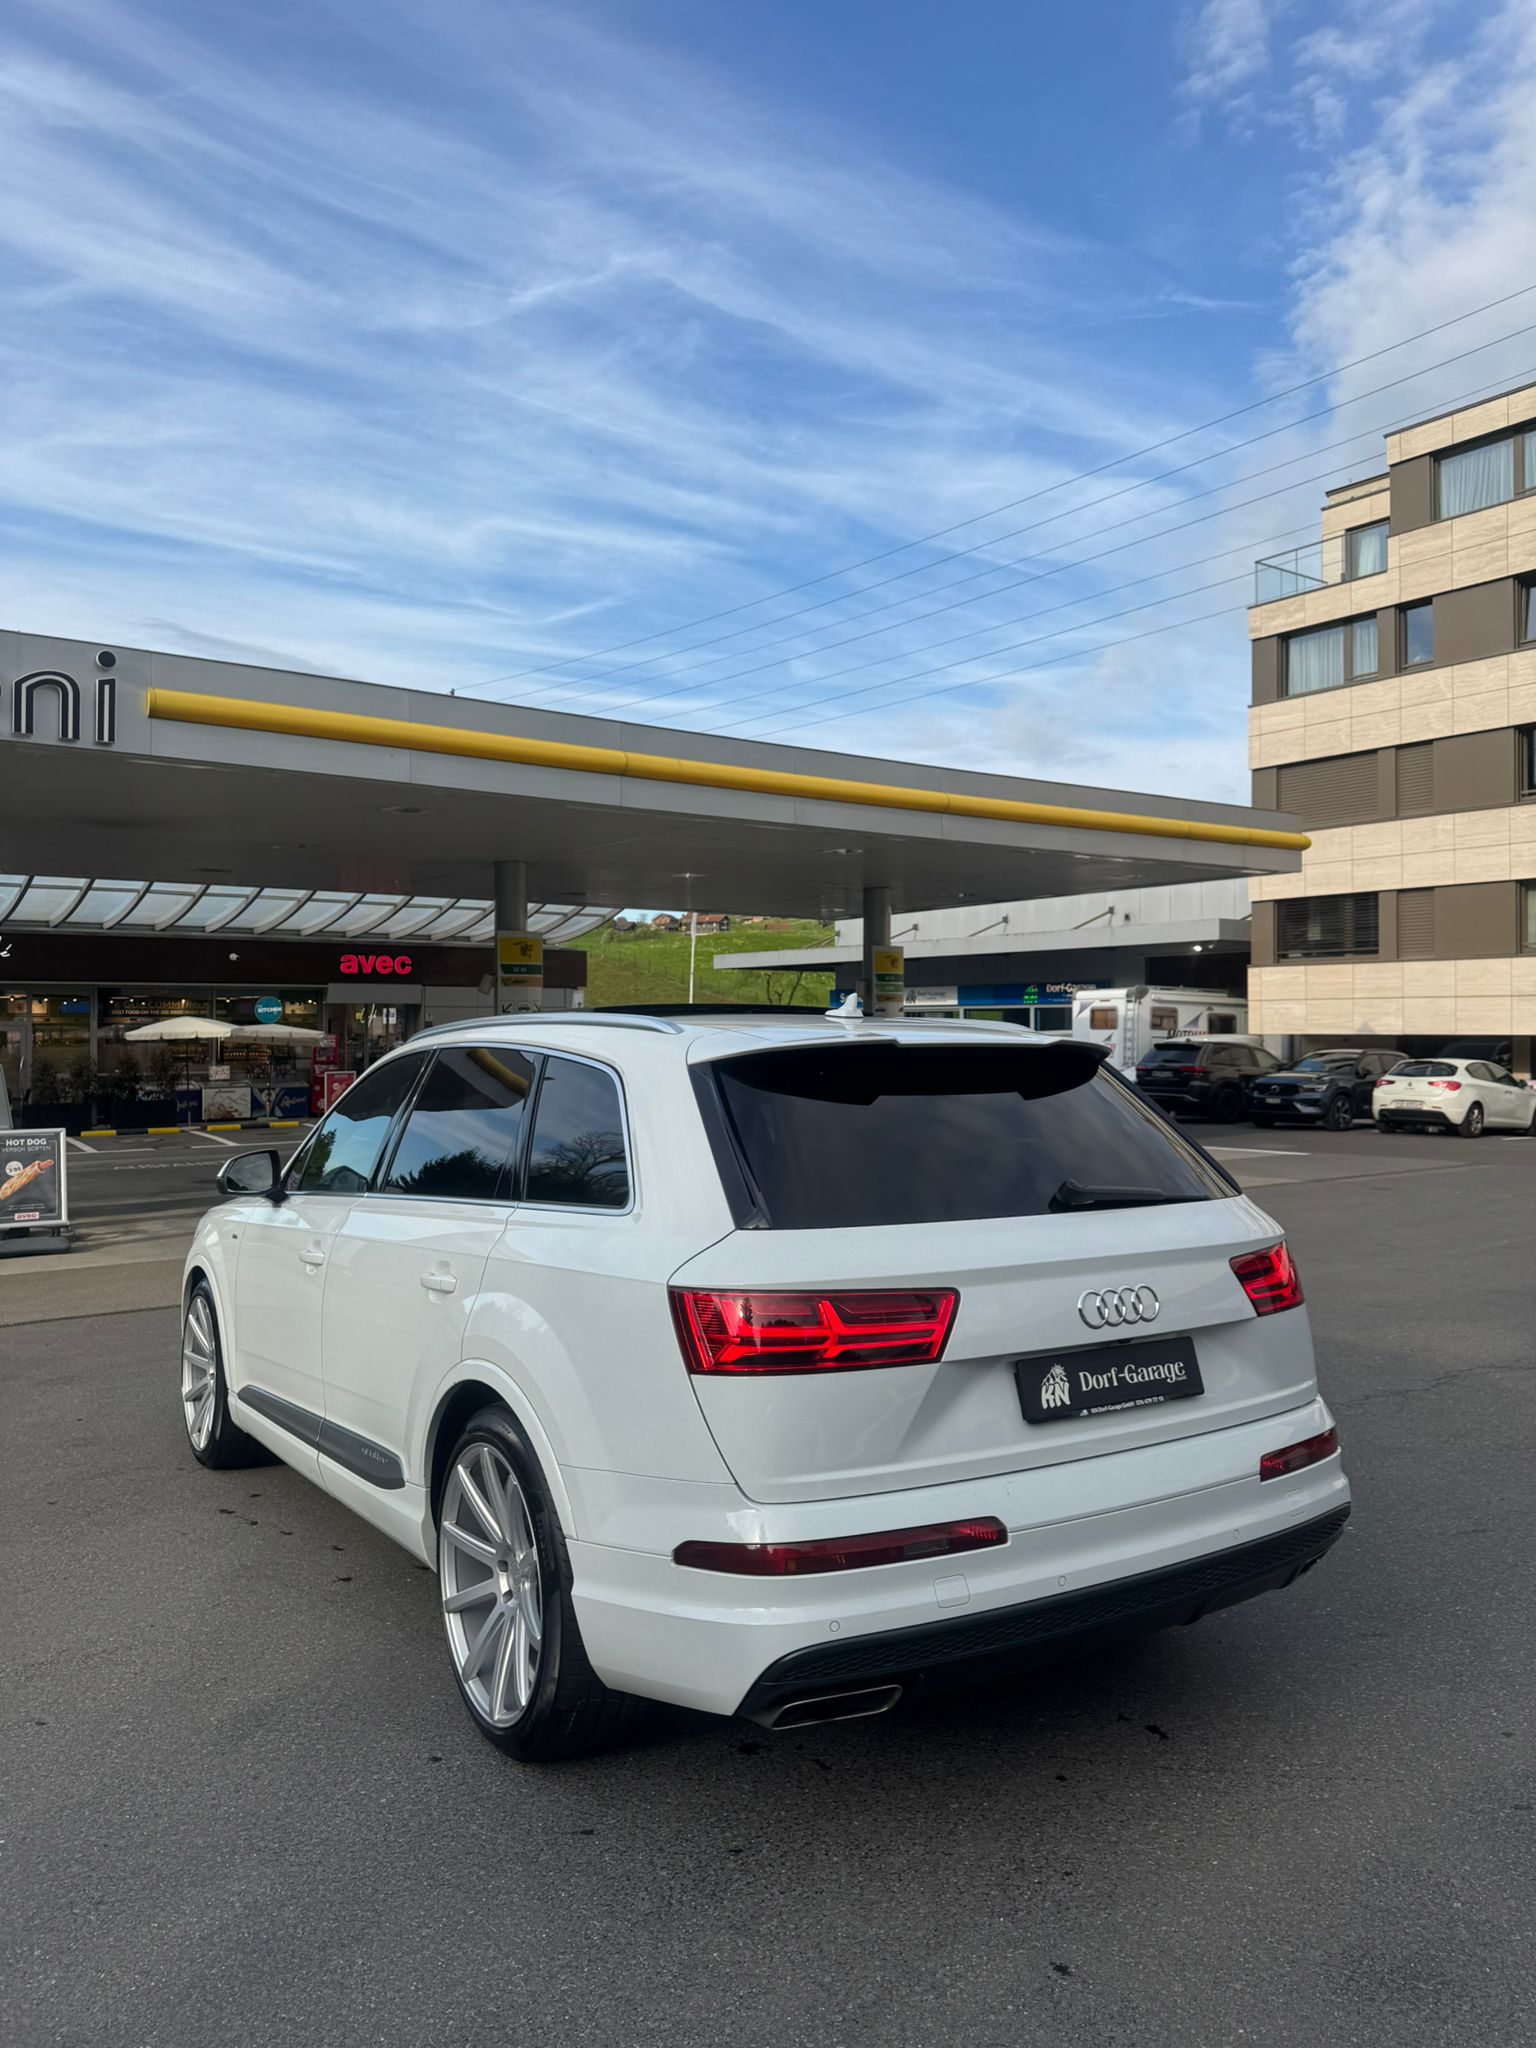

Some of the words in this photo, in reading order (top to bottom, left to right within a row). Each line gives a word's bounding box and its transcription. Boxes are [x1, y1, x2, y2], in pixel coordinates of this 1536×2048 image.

[0, 650, 116, 743] ni
[340, 955, 412, 974] avec
[5, 1138, 26, 1147] HOT
[26, 1138, 47, 1146] DOG
[1041, 1382, 1071, 1410] KN
[1079, 1360, 1186, 1392] Dorf-Garage
